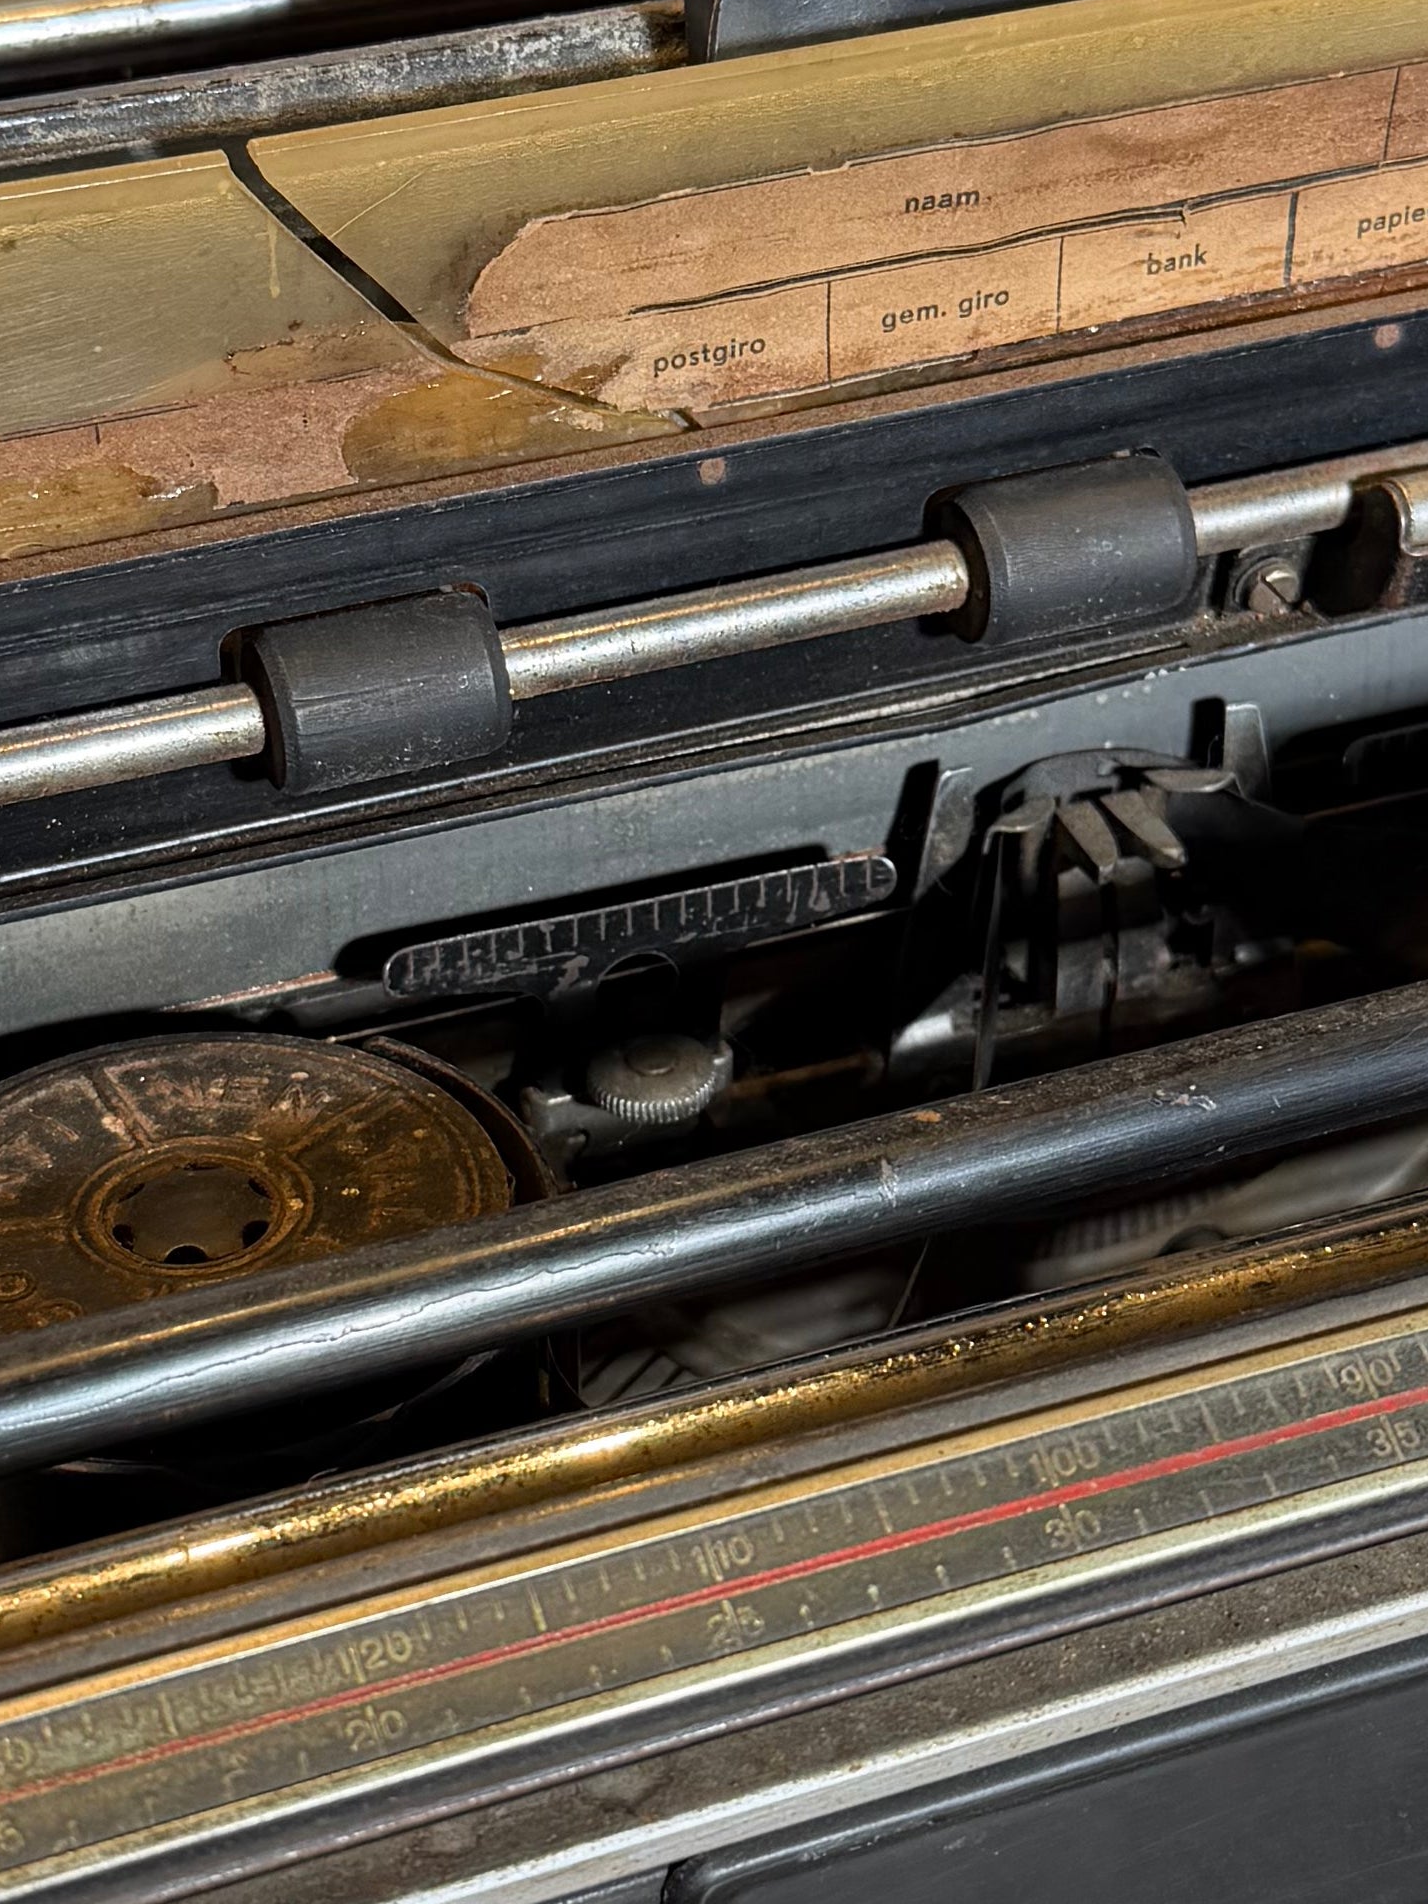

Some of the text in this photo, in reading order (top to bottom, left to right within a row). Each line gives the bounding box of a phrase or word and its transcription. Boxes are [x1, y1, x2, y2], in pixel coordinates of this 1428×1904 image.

[903, 189, 981, 214] naam
[1144, 244, 1209, 277] bank
[880, 288, 1010, 333] gem. giro
[651, 334, 767, 377] postgiro
